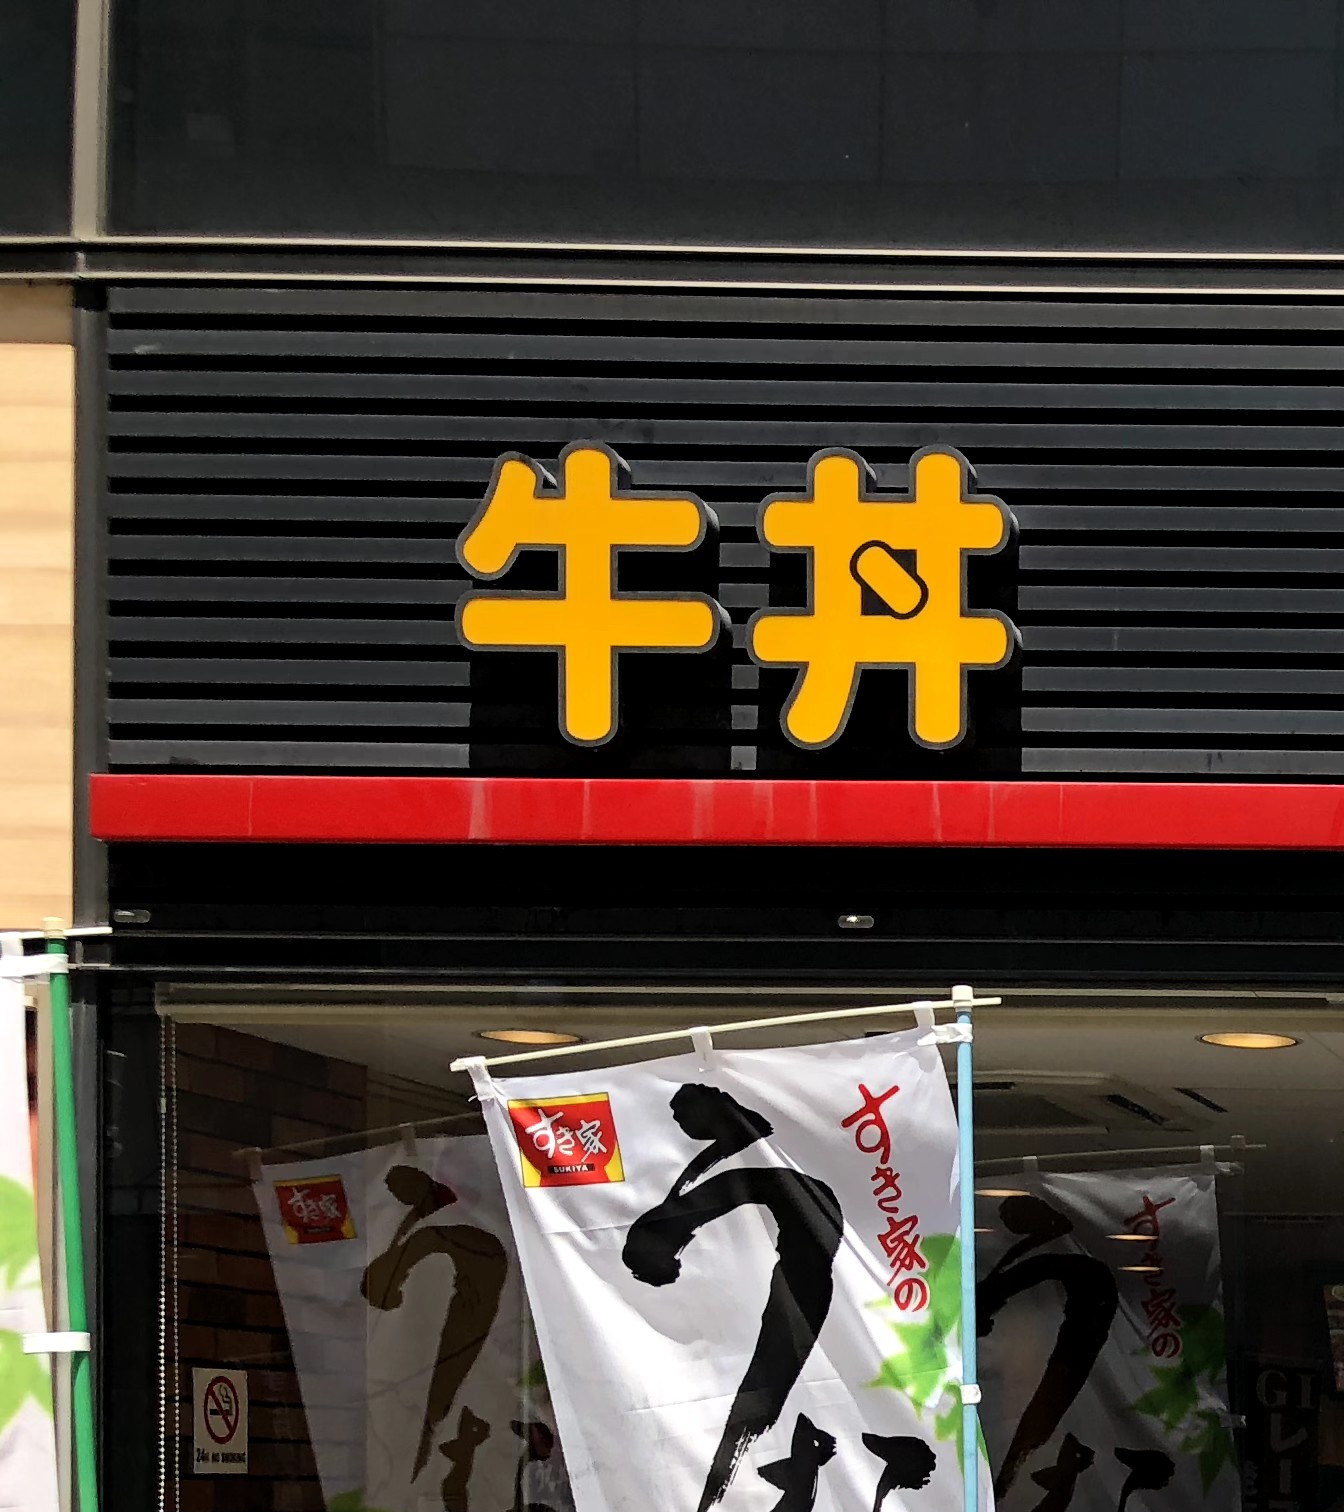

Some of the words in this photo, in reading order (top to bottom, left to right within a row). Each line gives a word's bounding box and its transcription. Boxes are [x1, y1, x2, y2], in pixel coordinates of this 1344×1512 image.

[457, 443, 1012, 747] 牛丼
[524, 1109, 608, 1164] すき家
[552, 1163, 590, 1174] SUKIYA
[841, 1083, 930, 1313] すき家の
